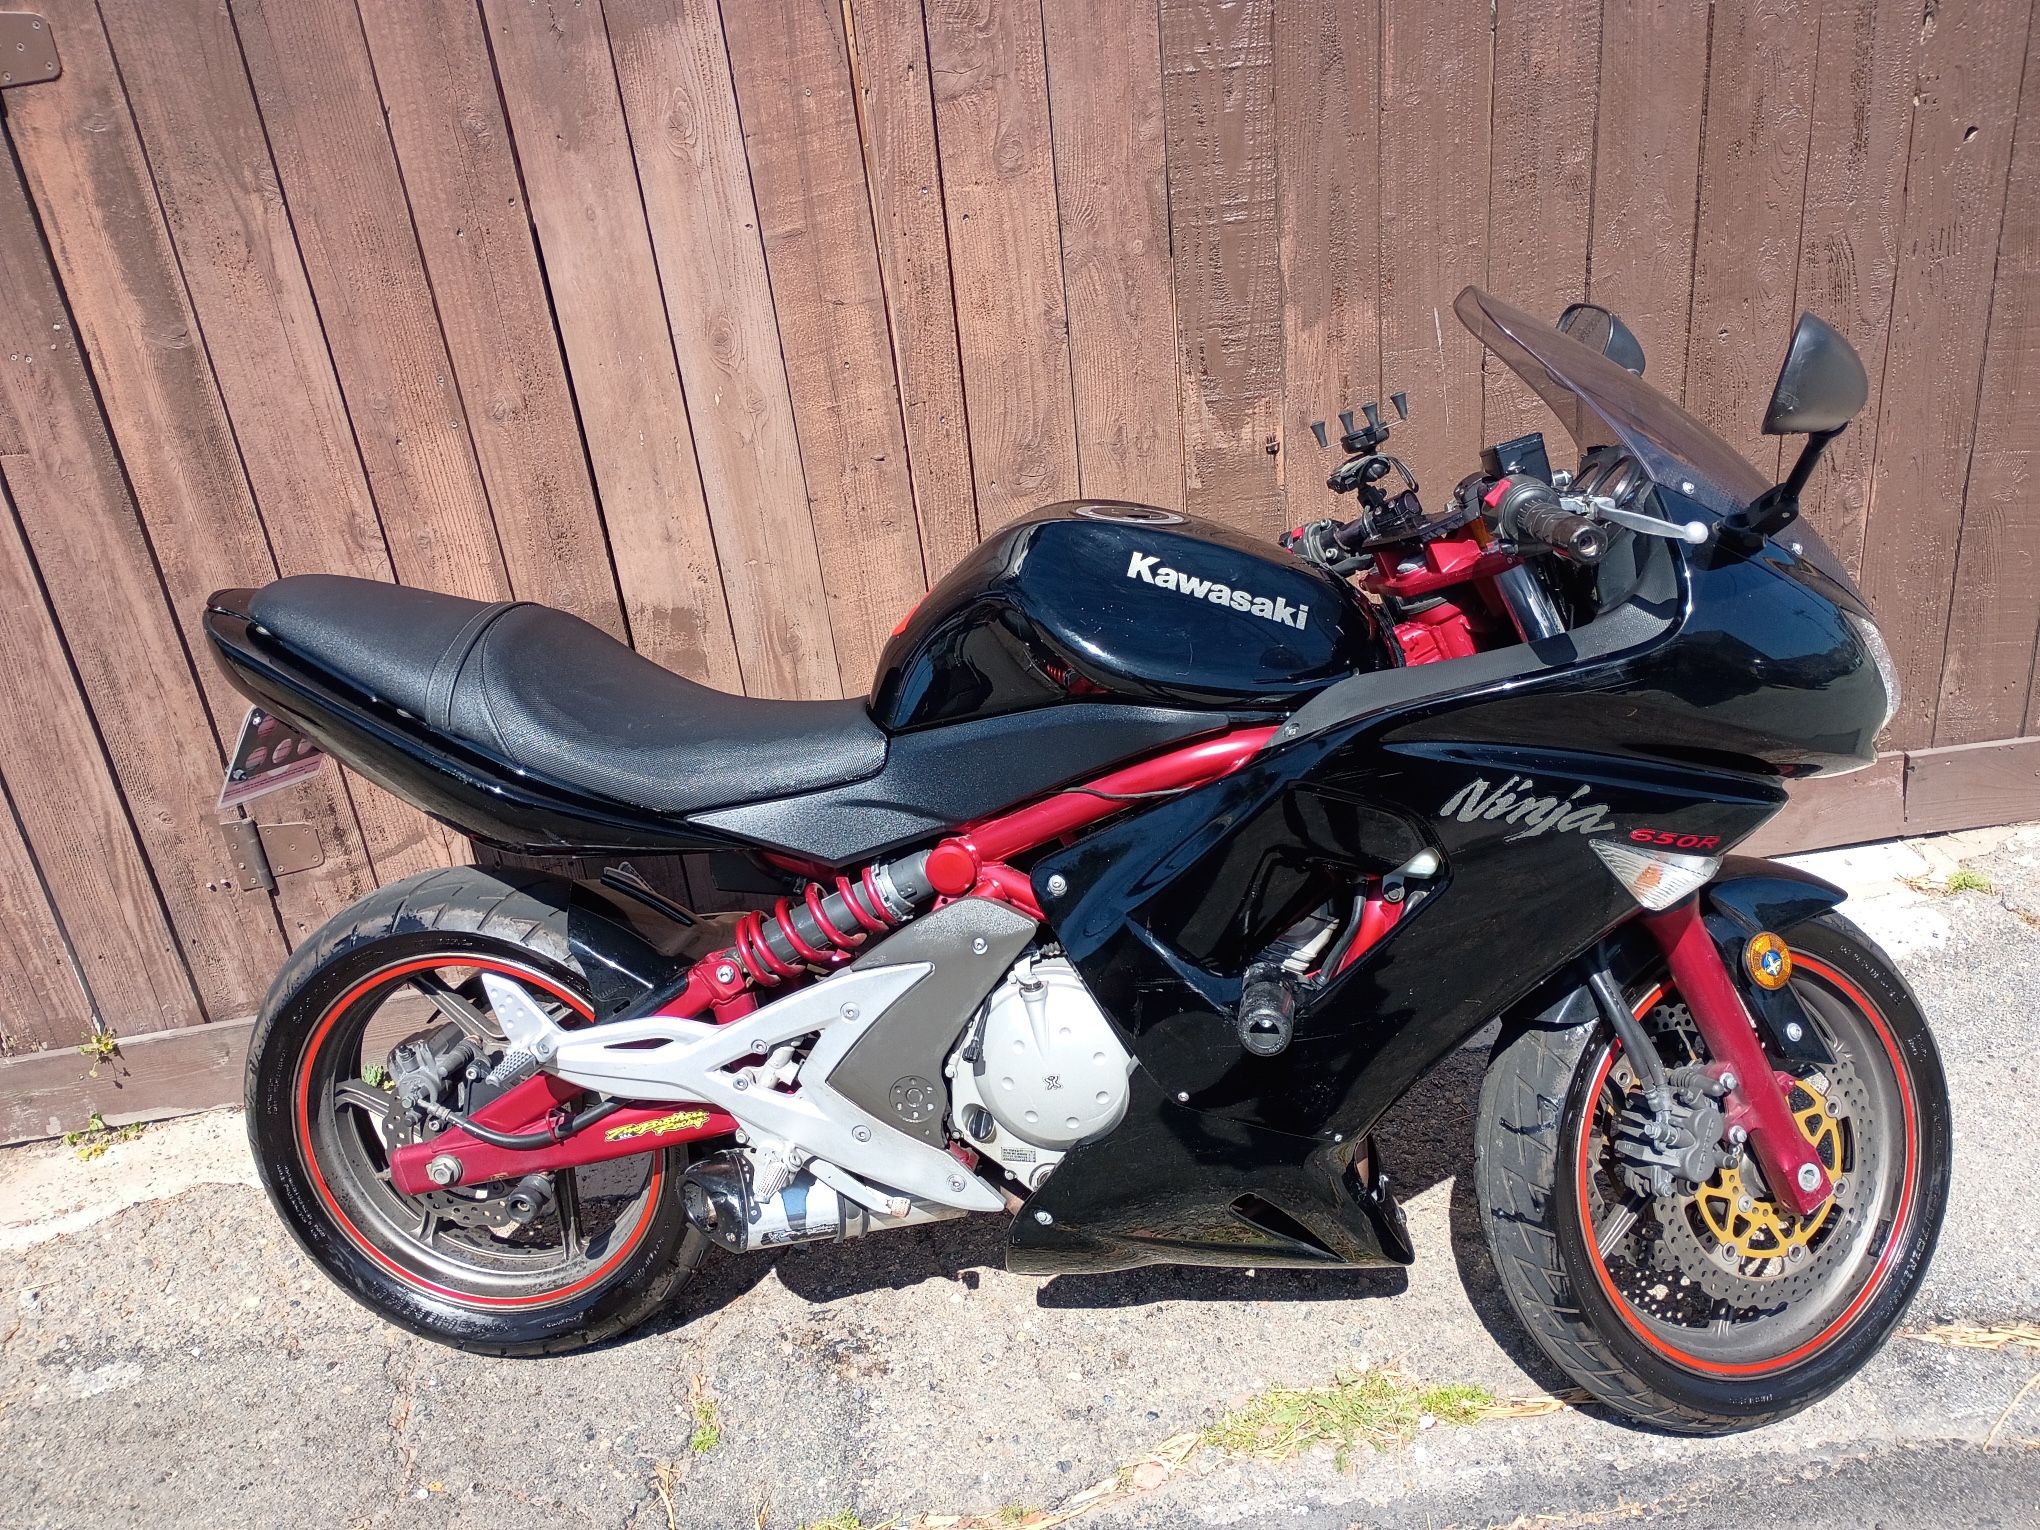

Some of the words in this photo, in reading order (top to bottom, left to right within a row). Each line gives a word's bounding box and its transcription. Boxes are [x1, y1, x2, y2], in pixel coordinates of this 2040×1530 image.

[1126, 551, 1310, 631] Kawasaki
[1439, 775, 1616, 843] Ninja
[1628, 827, 1721, 850] 650R
